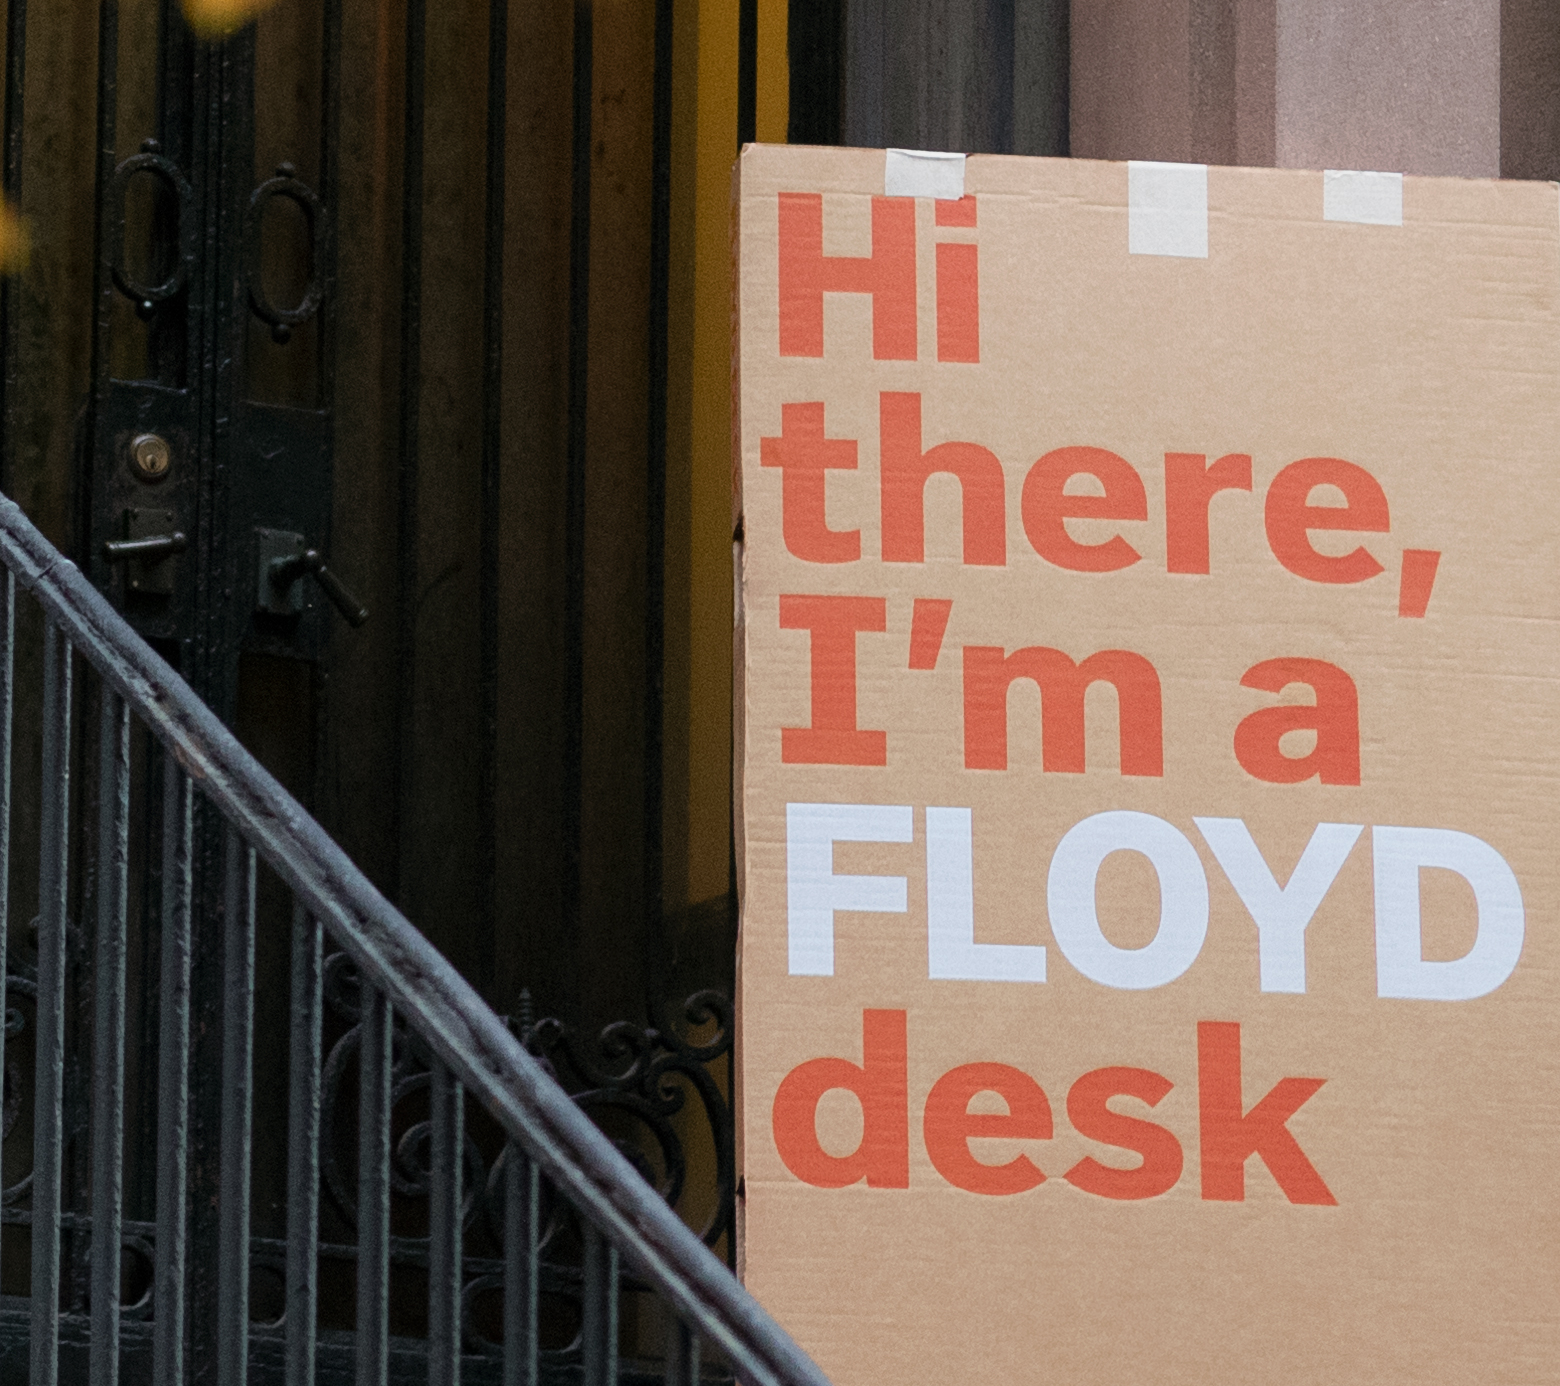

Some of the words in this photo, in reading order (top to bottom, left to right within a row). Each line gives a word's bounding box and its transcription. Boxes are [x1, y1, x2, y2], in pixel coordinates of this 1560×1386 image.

[778, 192, 980, 363] Hi
[761, 392, 1441, 618] there,
[1233, 657, 1361, 785] a
[786, 802, 1525, 1004] FLOYD
[772, 1009, 1340, 1206] desk
